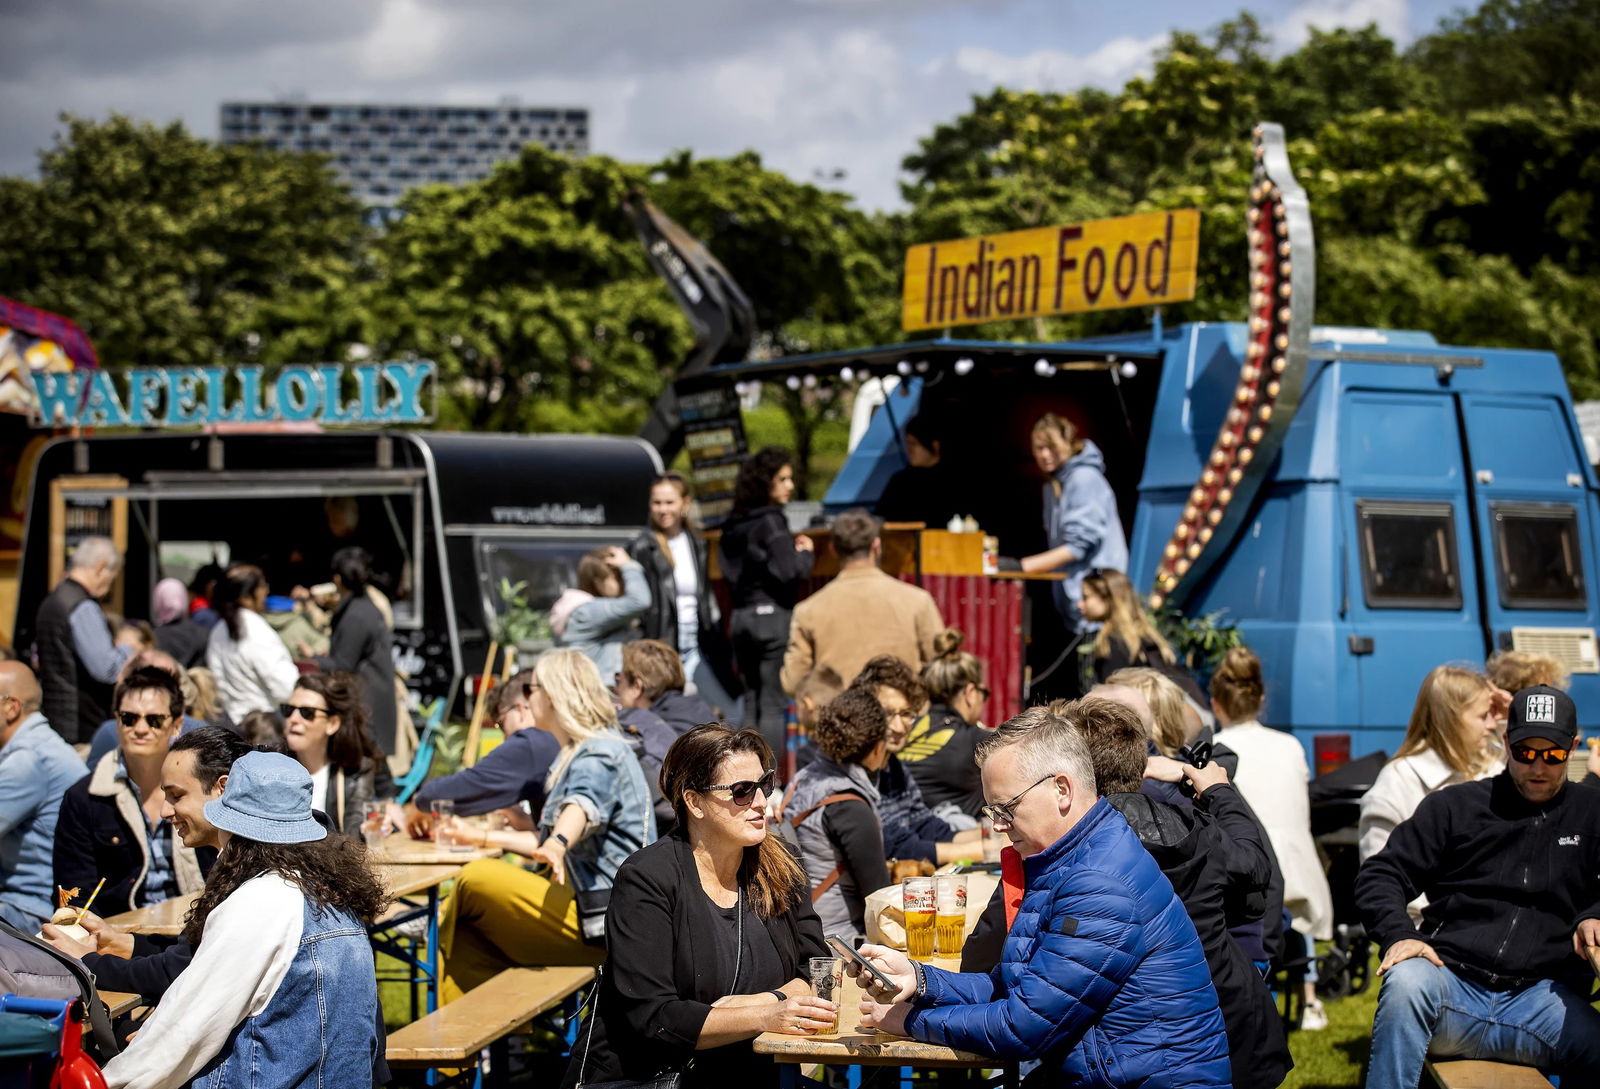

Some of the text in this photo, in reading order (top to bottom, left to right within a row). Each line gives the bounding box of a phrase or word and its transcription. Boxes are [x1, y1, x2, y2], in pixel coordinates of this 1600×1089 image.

[924, 213, 1175, 324] Indian Food
[31, 361, 436, 425] WAFELLOLLY
[1529, 696, 1552, 704] AMS
[1529, 704, 1552, 712] TER
[1529, 712, 1552, 720] DAM
